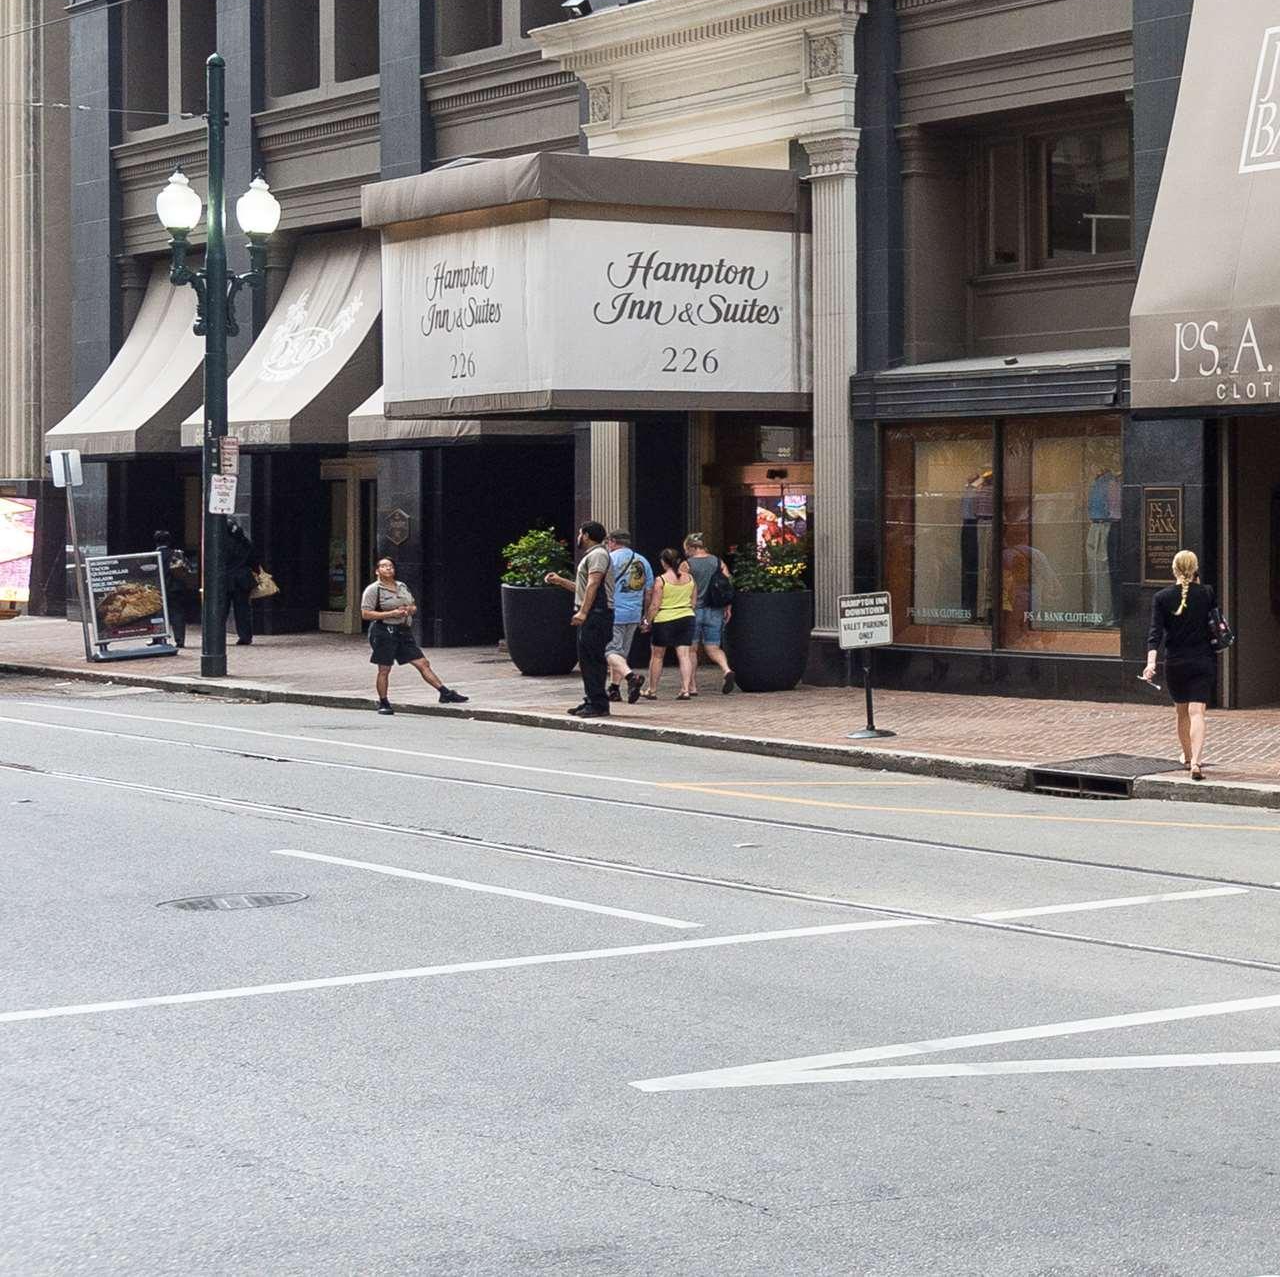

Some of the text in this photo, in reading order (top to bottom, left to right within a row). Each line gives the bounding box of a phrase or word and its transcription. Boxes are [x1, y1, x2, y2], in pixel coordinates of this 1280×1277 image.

[426, 260, 494, 301] Hampton
[607, 250, 768, 290] Hampton
[421, 297, 501, 336] Inn & Suites
[594, 292, 781, 326] Inn & Suites
[662, 347, 718, 373] 226
[1230, 318, 1273, 373] A.
[450, 352, 475, 379] 226
[1044, 611, 1064, 622] BANK
[1064, 612, 1104, 623] CLOTHIERS
